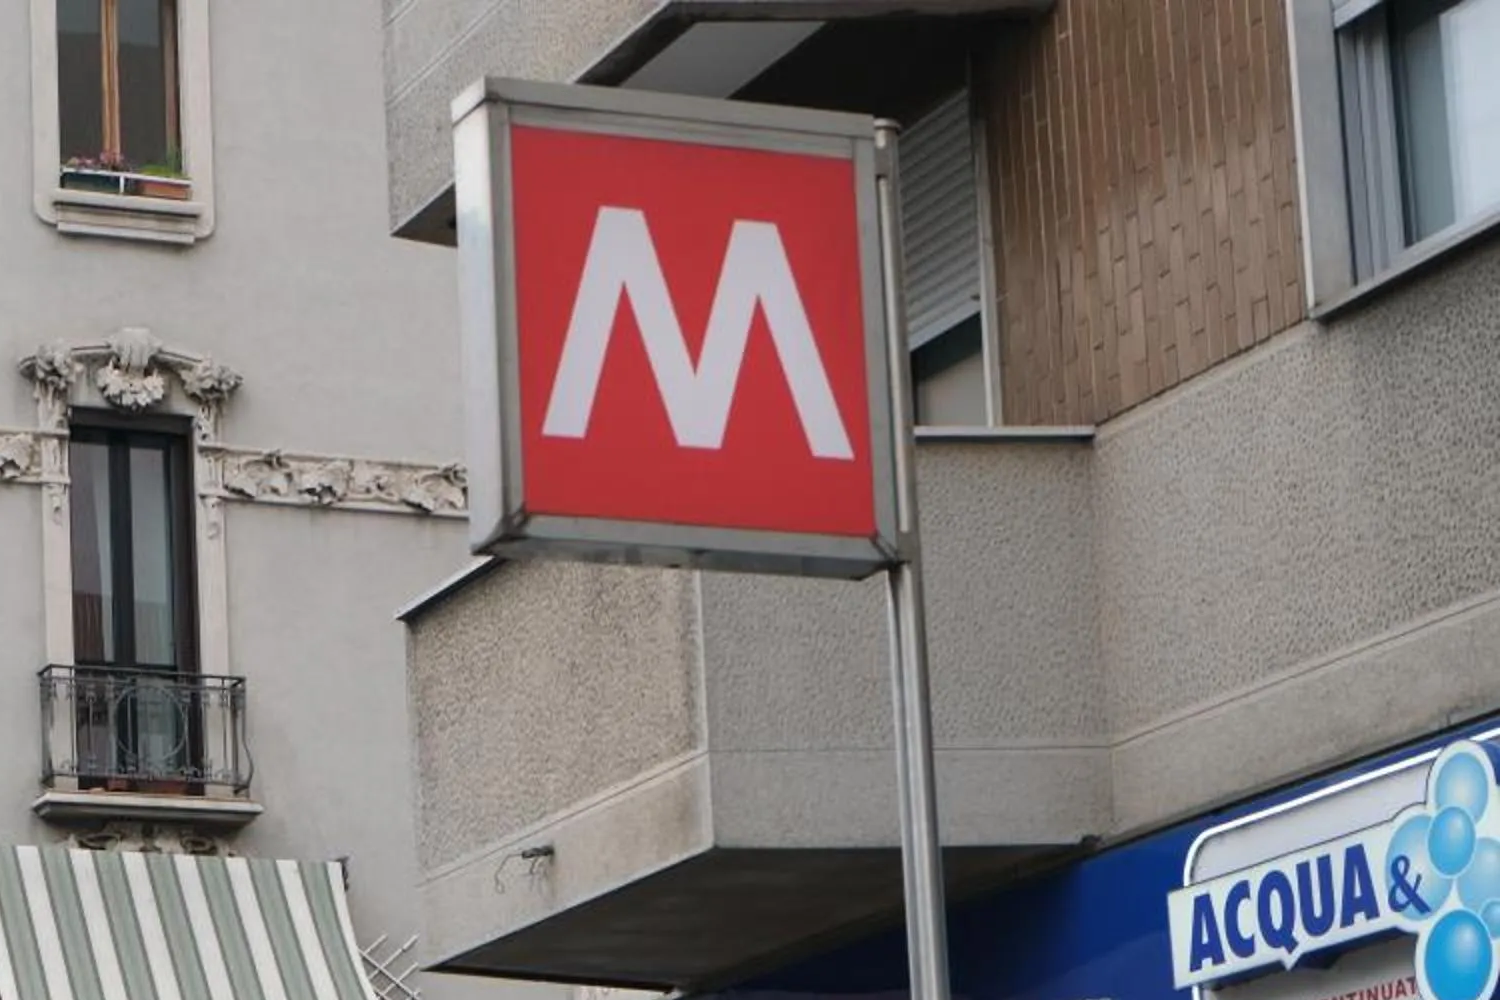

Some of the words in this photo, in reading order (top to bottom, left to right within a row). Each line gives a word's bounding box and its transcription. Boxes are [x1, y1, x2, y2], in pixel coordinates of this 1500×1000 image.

[543, 205, 855, 461] M
[1190, 843, 1380, 972] ACQUA
[1388, 855, 1432, 914] &
